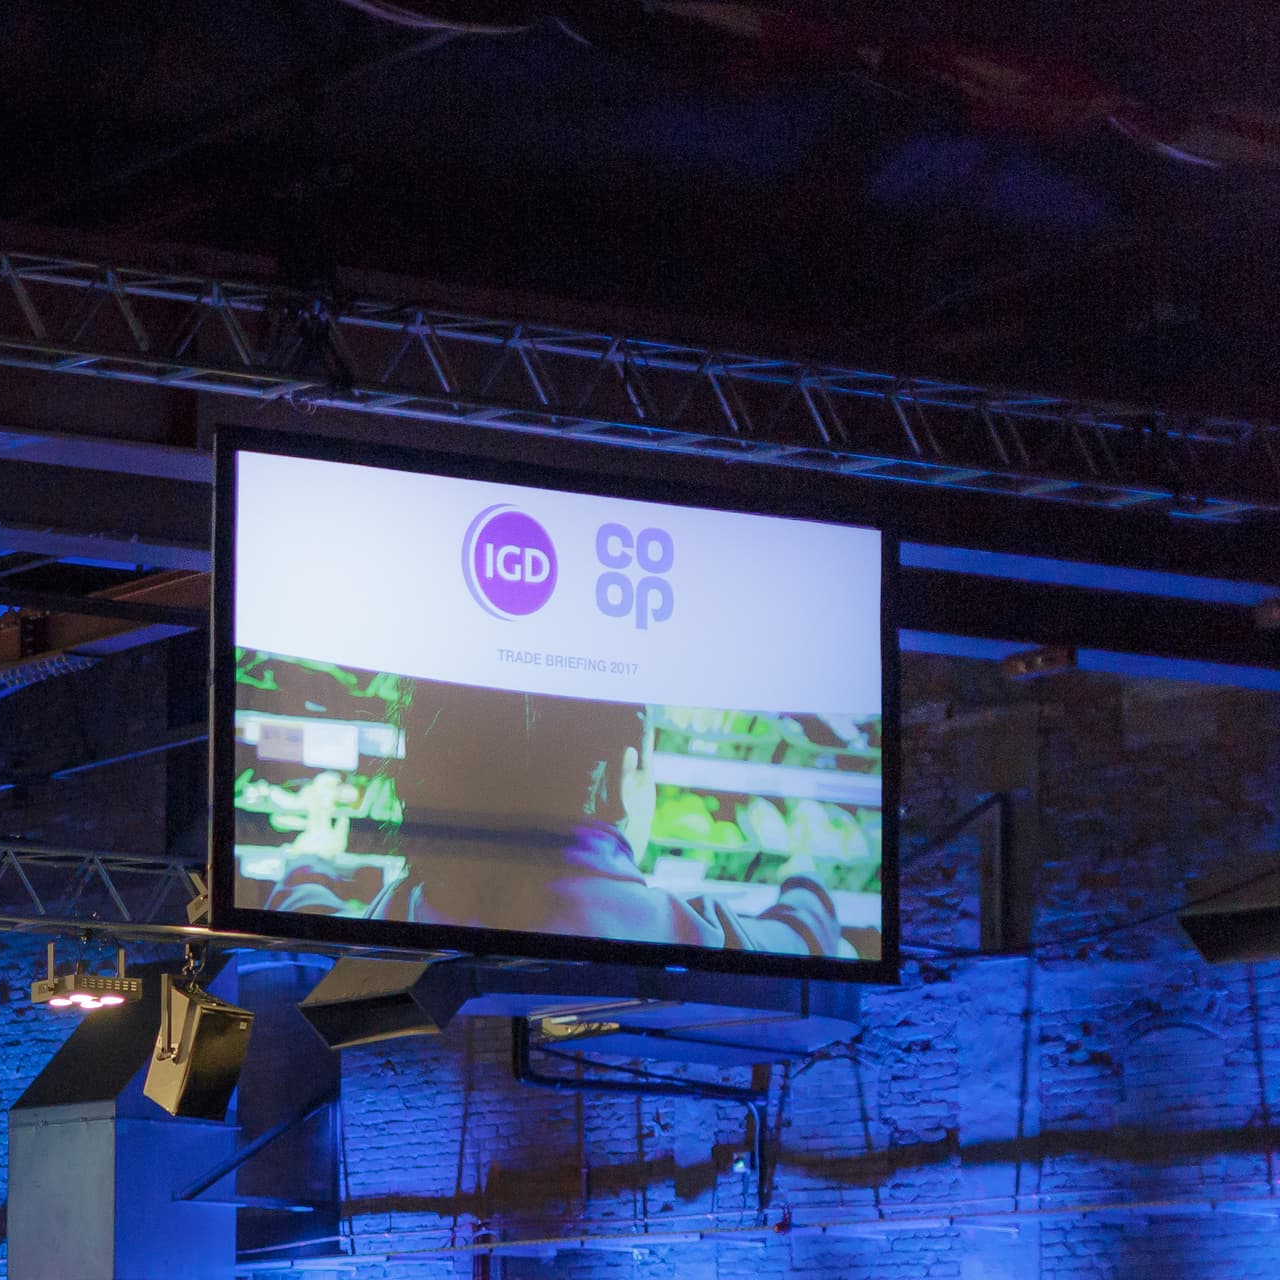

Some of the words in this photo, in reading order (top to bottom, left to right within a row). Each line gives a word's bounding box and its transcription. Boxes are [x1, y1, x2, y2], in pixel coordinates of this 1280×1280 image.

[485, 543, 550, 583] IGD
[497, 649, 542, 665] TRADE
[546, 654, 607, 672] BRIEFING
[610, 661, 639, 676] 2017
